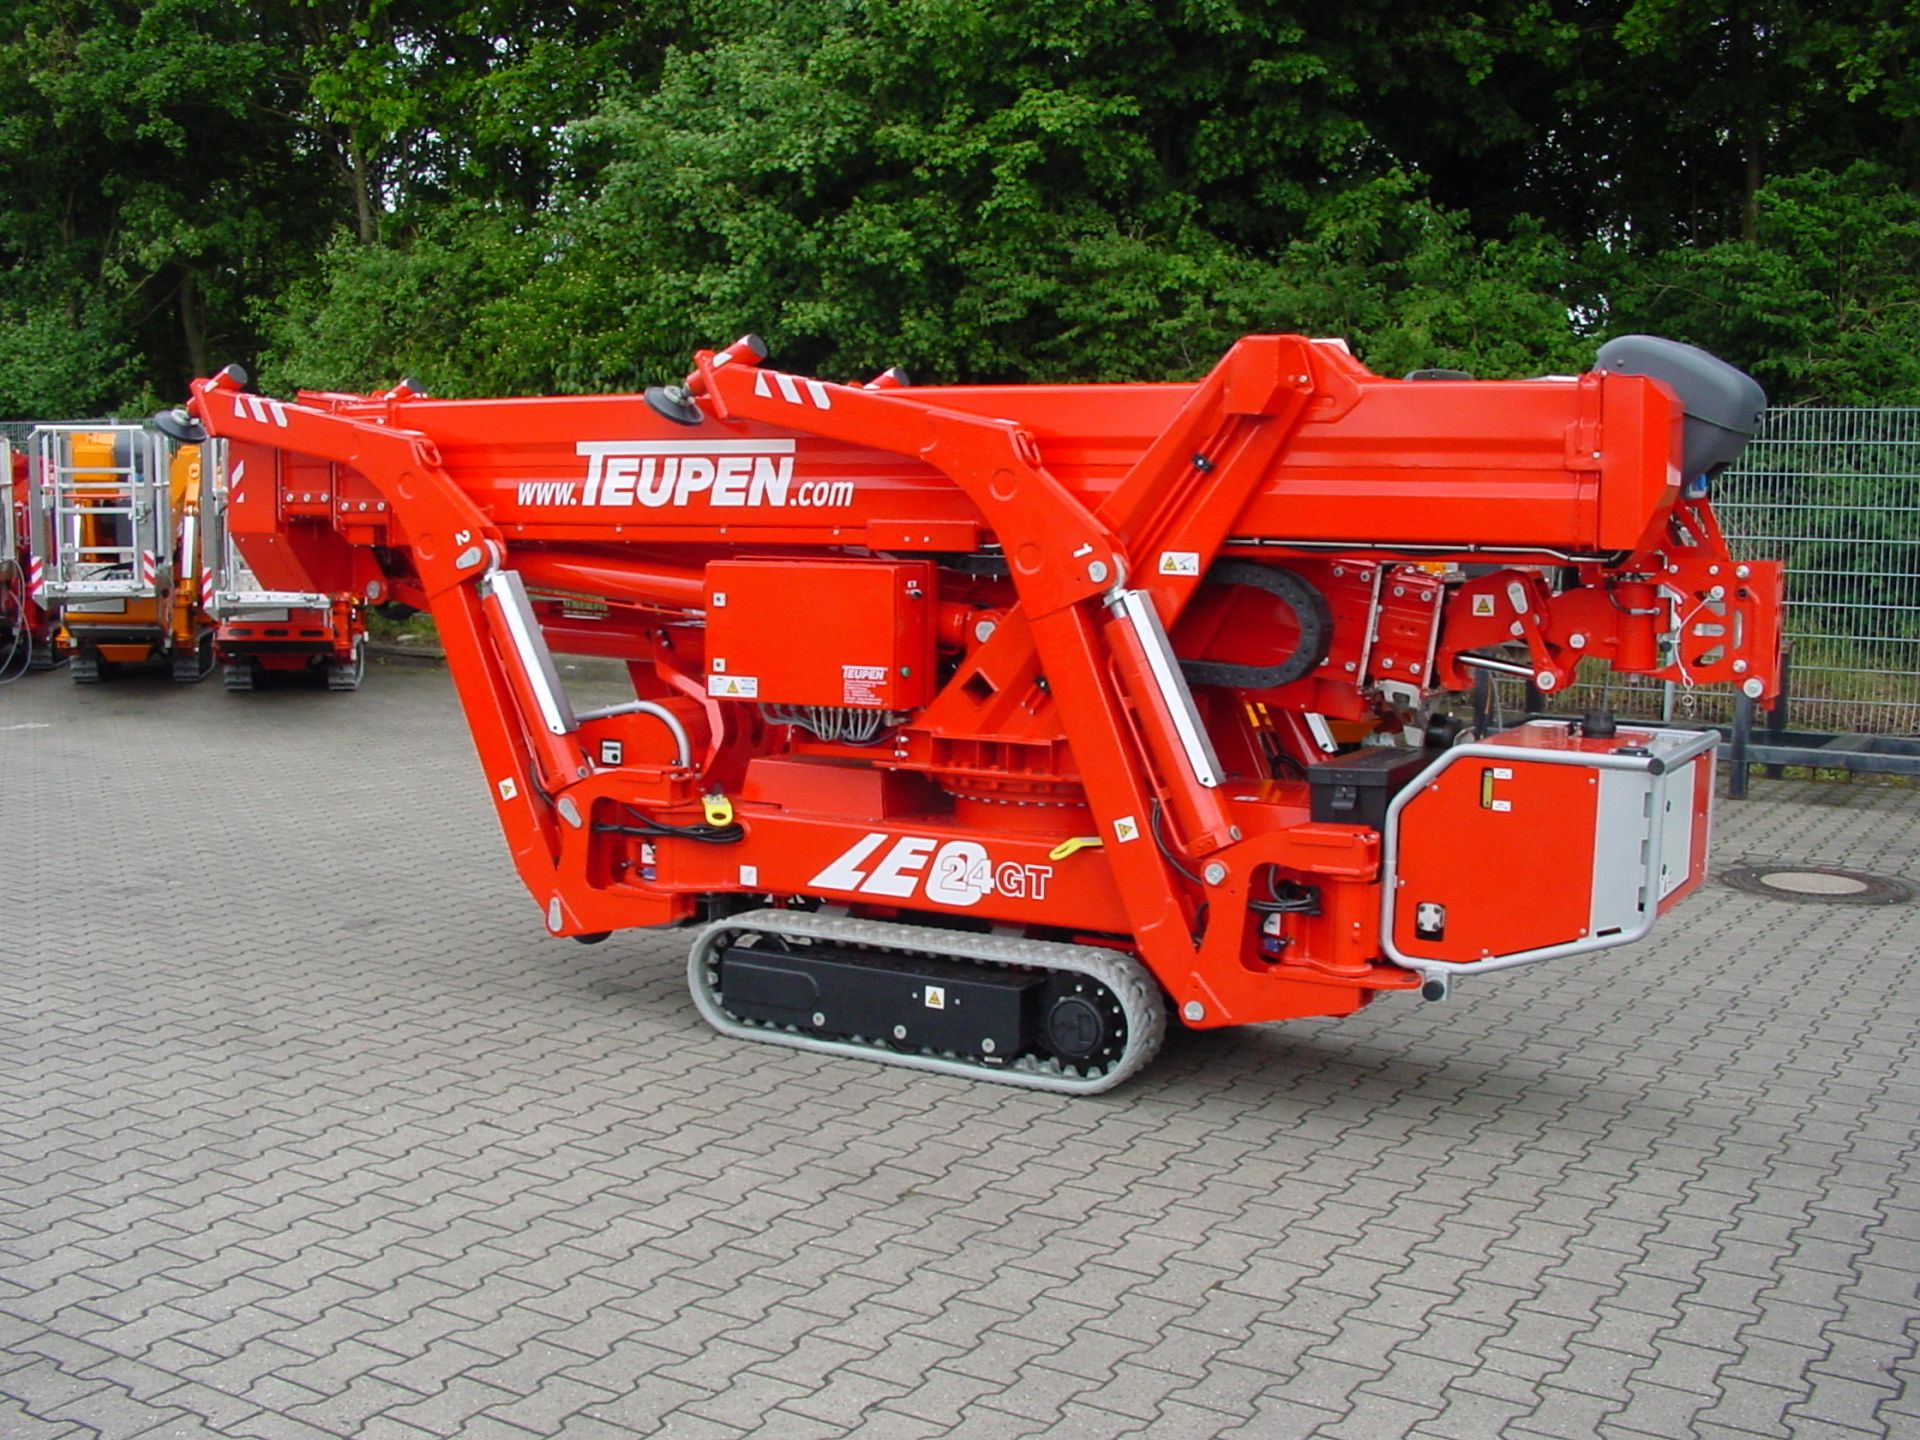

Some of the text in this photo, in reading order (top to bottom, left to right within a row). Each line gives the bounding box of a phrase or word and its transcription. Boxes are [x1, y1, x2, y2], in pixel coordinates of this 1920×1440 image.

[517, 439, 855, 507] www.TEUPEN.com
[455, 529, 471, 546] 2
[1073, 543, 1093, 558] 1
[841, 664, 889, 681] TEUPEN
